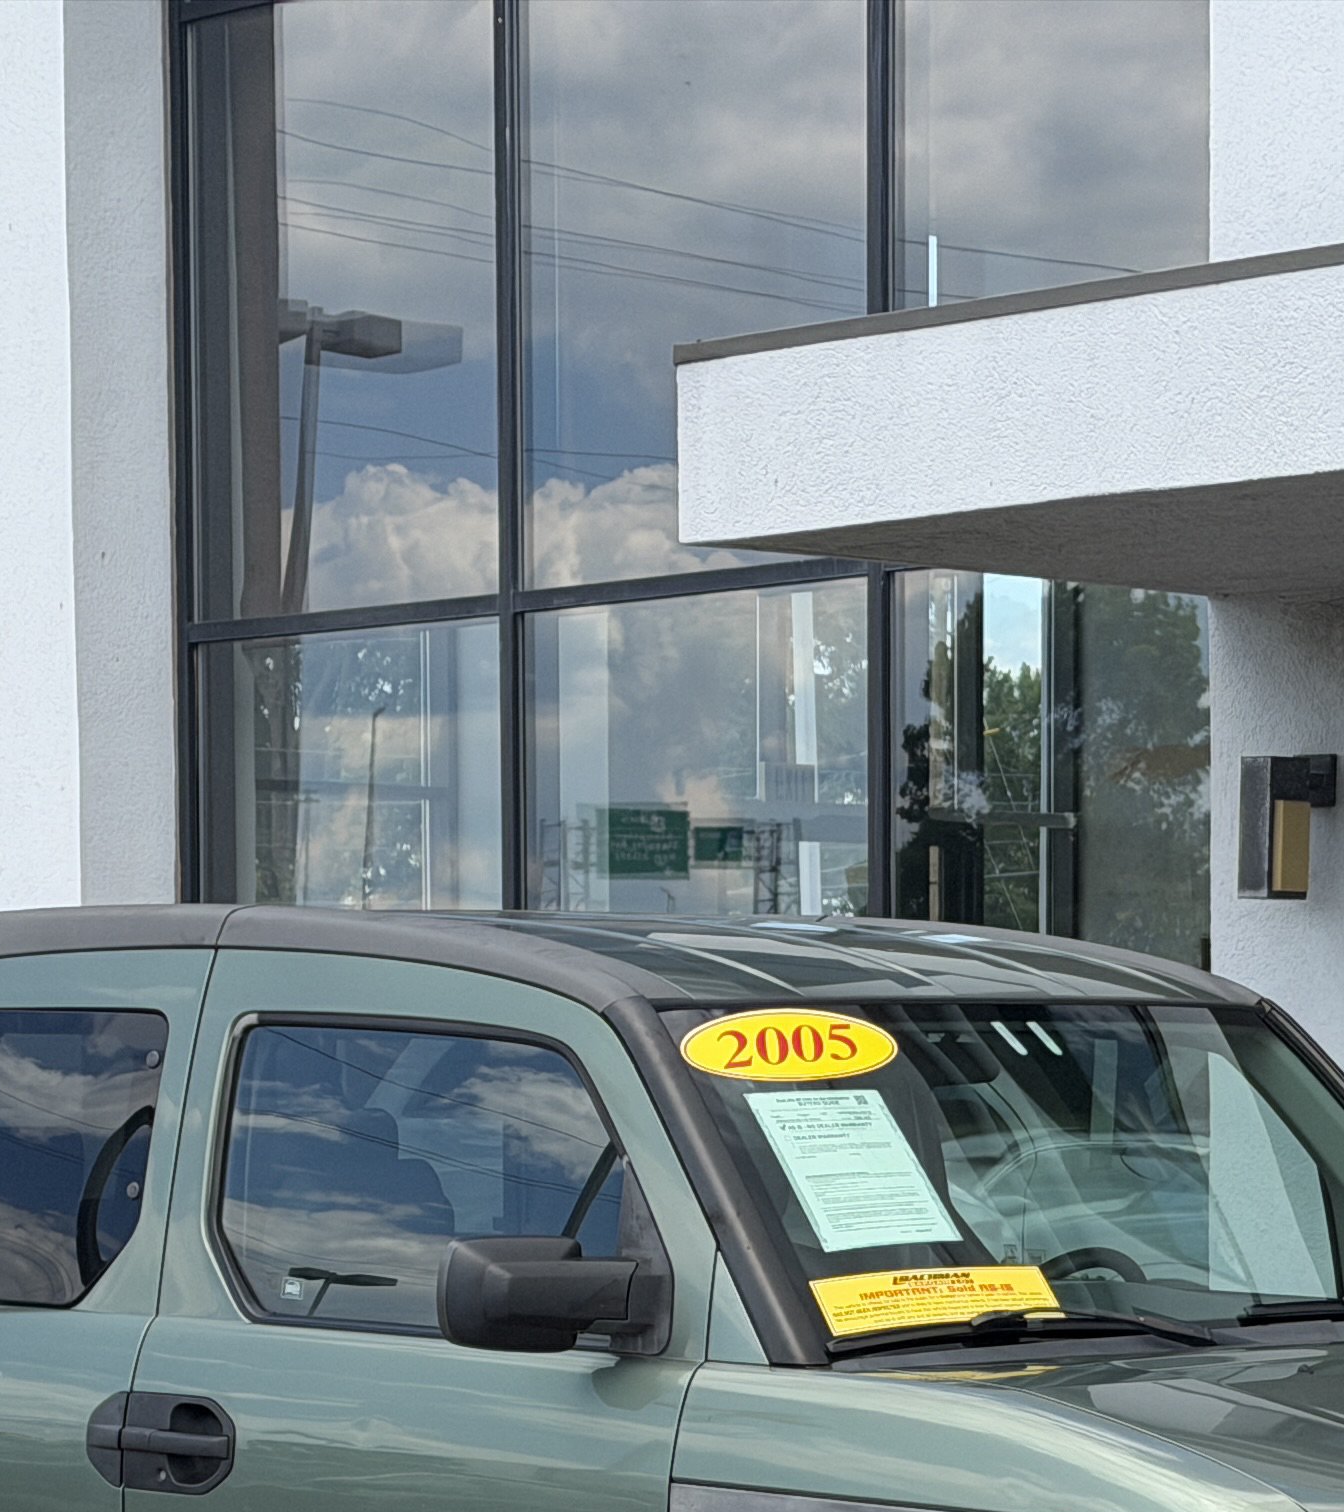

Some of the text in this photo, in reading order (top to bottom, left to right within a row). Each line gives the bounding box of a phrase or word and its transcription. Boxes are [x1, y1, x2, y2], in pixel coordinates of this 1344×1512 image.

[717, 1024, 858, 1069] 2005
[859, 1286, 943, 1300] IMPORTANT:
[947, 1281, 975, 1293] Sold
[978, 1283, 1014, 1292] AS-IS
